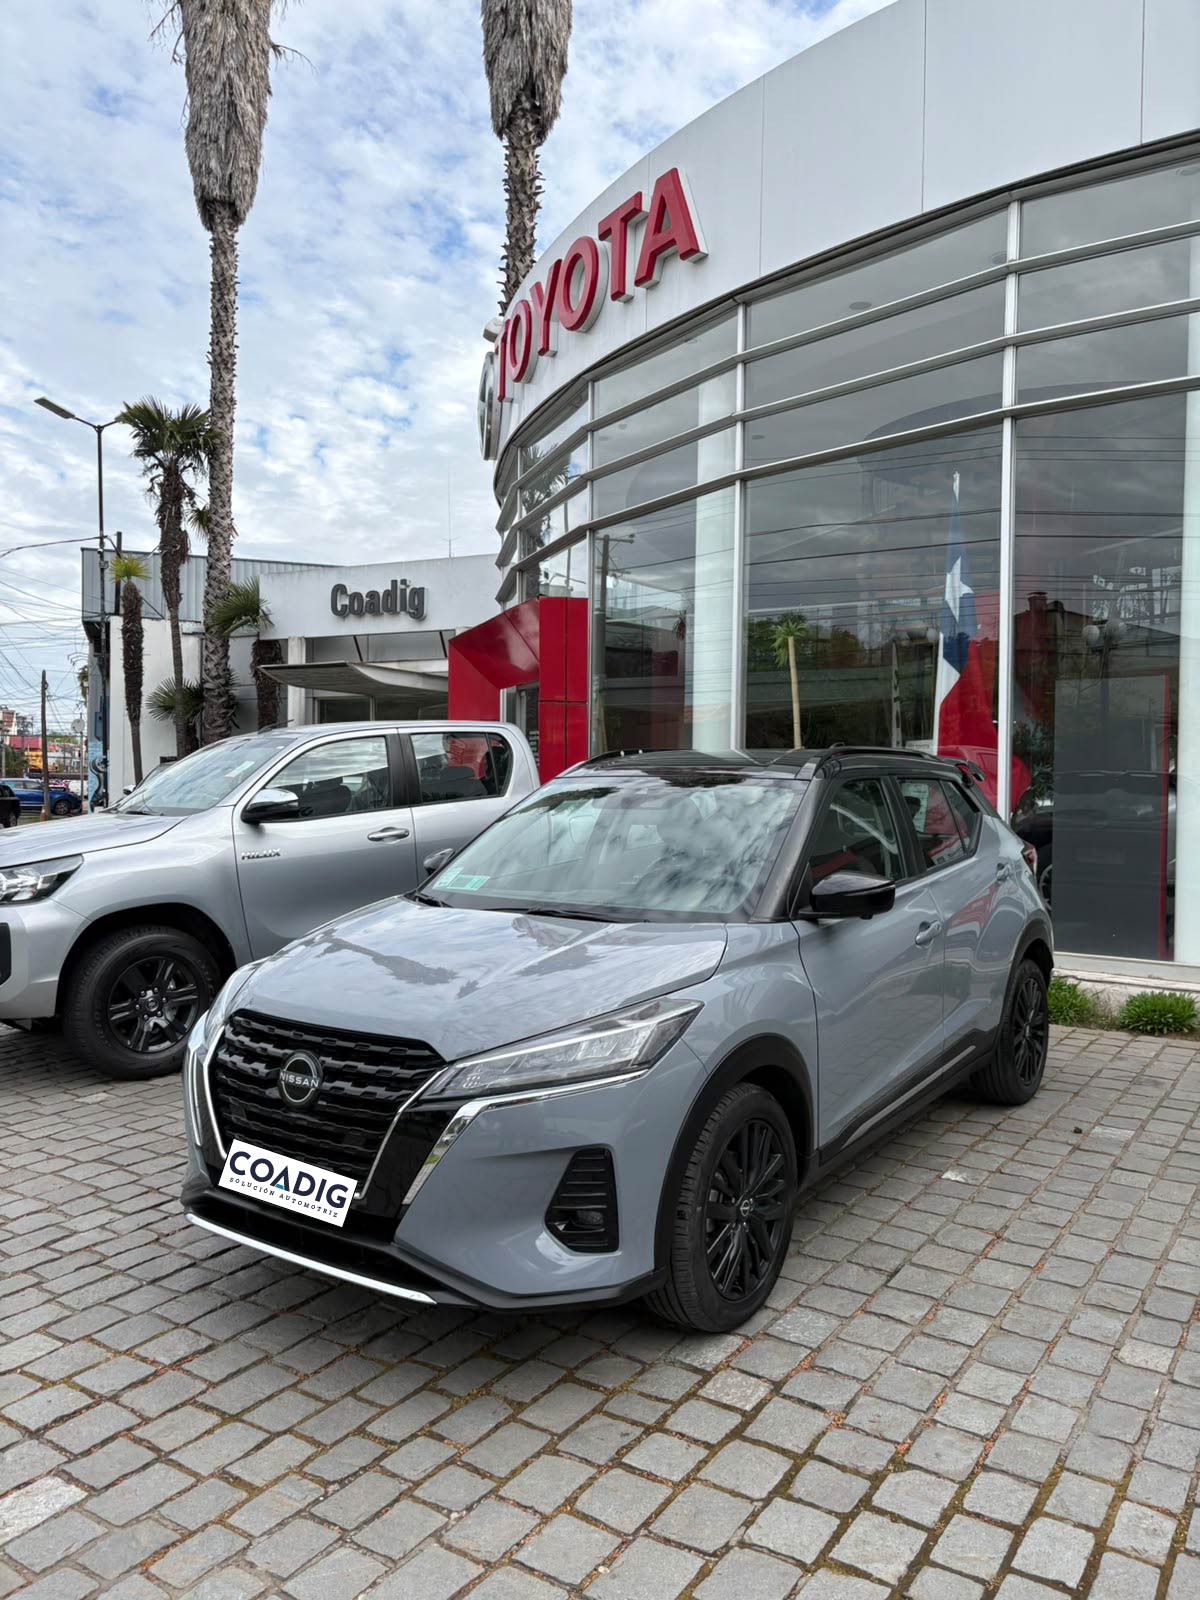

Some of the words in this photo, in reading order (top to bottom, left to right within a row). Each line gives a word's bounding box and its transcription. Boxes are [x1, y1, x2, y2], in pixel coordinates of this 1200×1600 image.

[495, 167, 701, 402] TOYOTA
[331, 579, 426, 620] Coadig
[280, 1072, 320, 1088] NISSAN
